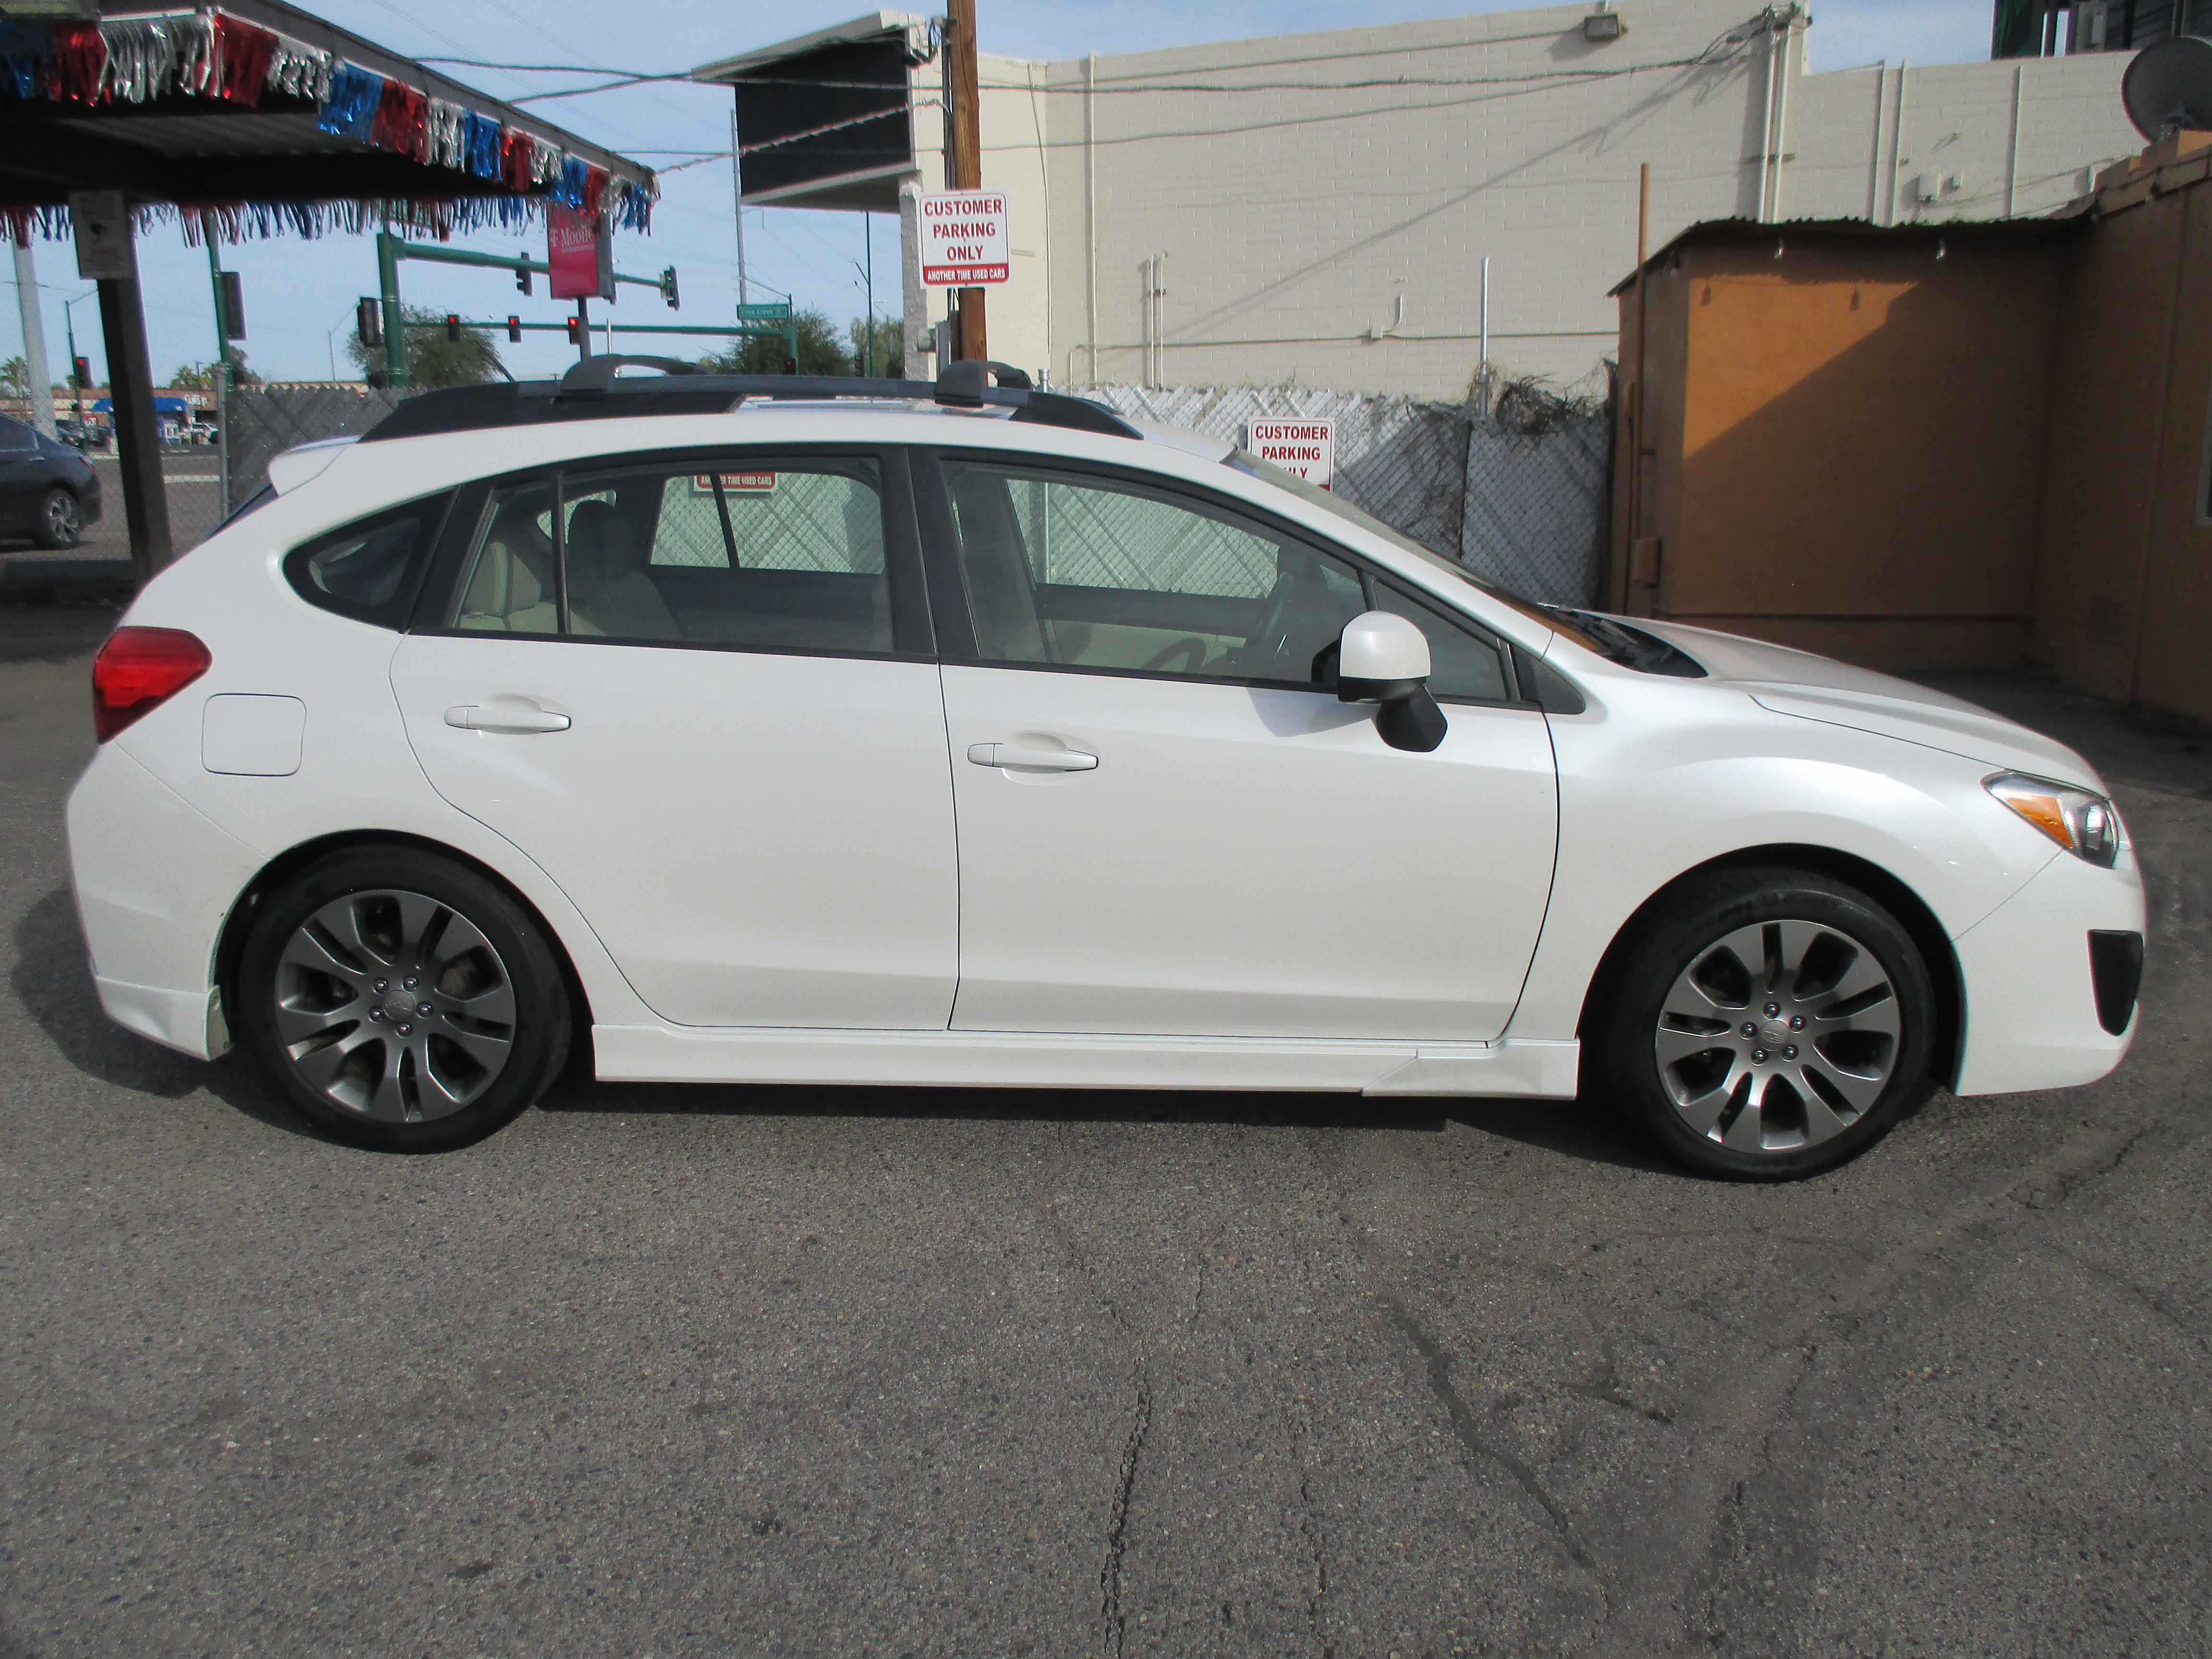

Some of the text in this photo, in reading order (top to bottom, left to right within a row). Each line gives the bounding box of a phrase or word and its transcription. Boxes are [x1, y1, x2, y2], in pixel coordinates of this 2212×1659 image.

[925, 199, 1002, 216] CUSTOMER
[933, 222, 996, 239] PARKING
[947, 245, 984, 261] ONLY
[927, 268, 1006, 281] ANOTHER TIME USED CARS
[1255, 426, 1329, 440] CUSTOMER
[1262, 446, 1321, 460] PARKING
[727, 476, 741, 485] TIME
[741, 476, 757, 485] USED
[757, 476, 772, 485] CARS
